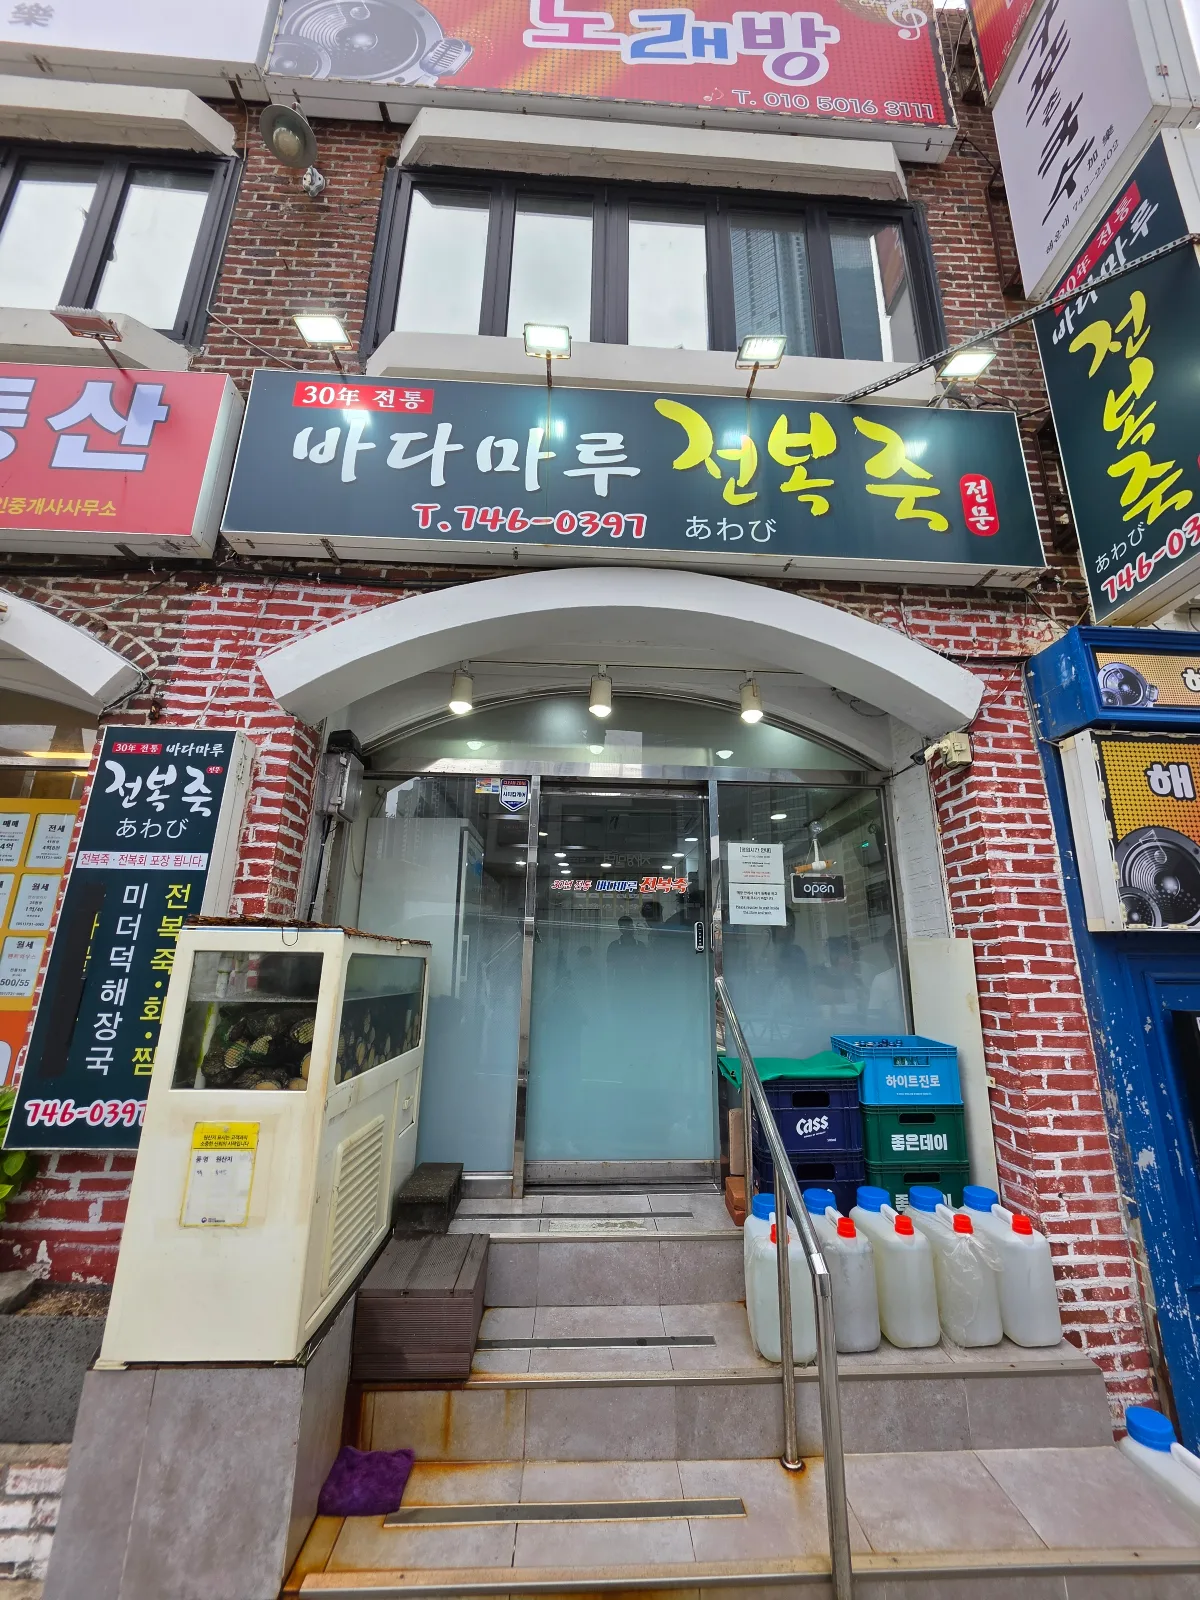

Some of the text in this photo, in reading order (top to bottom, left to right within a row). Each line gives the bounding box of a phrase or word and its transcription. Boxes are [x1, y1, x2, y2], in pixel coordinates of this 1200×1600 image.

[523, 0, 841, 87] 노래방
[732, 89, 934, 119] T. 010 5016 3111
[1098, 196, 1132, 248] 전통
[301, 386, 426, 410] 30年 전통
[1069, 290, 1193, 524] 전복죽
[292, 398, 950, 533] 바다마루 전복죽
[964, 479, 995, 531] 전문
[685, 515, 777, 543] あわび
[1095, 520, 1145, 573] あわび
[116, 742, 225, 757] 30年 전통 바다마루
[105, 760, 213, 817] 전복죽
[1147, 763, 1195, 799] 해
[48, 824, 66, 832] 전세
[116, 817, 189, 839] あわび
[80, 853, 204, 868] 전복죽 전복회 포장 됩니다.
[31, 882, 50, 891] 월세
[640, 876, 689, 893] 전복죽
[803, 883, 835, 896] open
[16, 940, 34, 949] 월세
[85, 882, 149, 1076] 미더덕해장국
[886, 1075, 941, 1088] 하이트진로
[891, 1133, 948, 1151] 좋은데이
